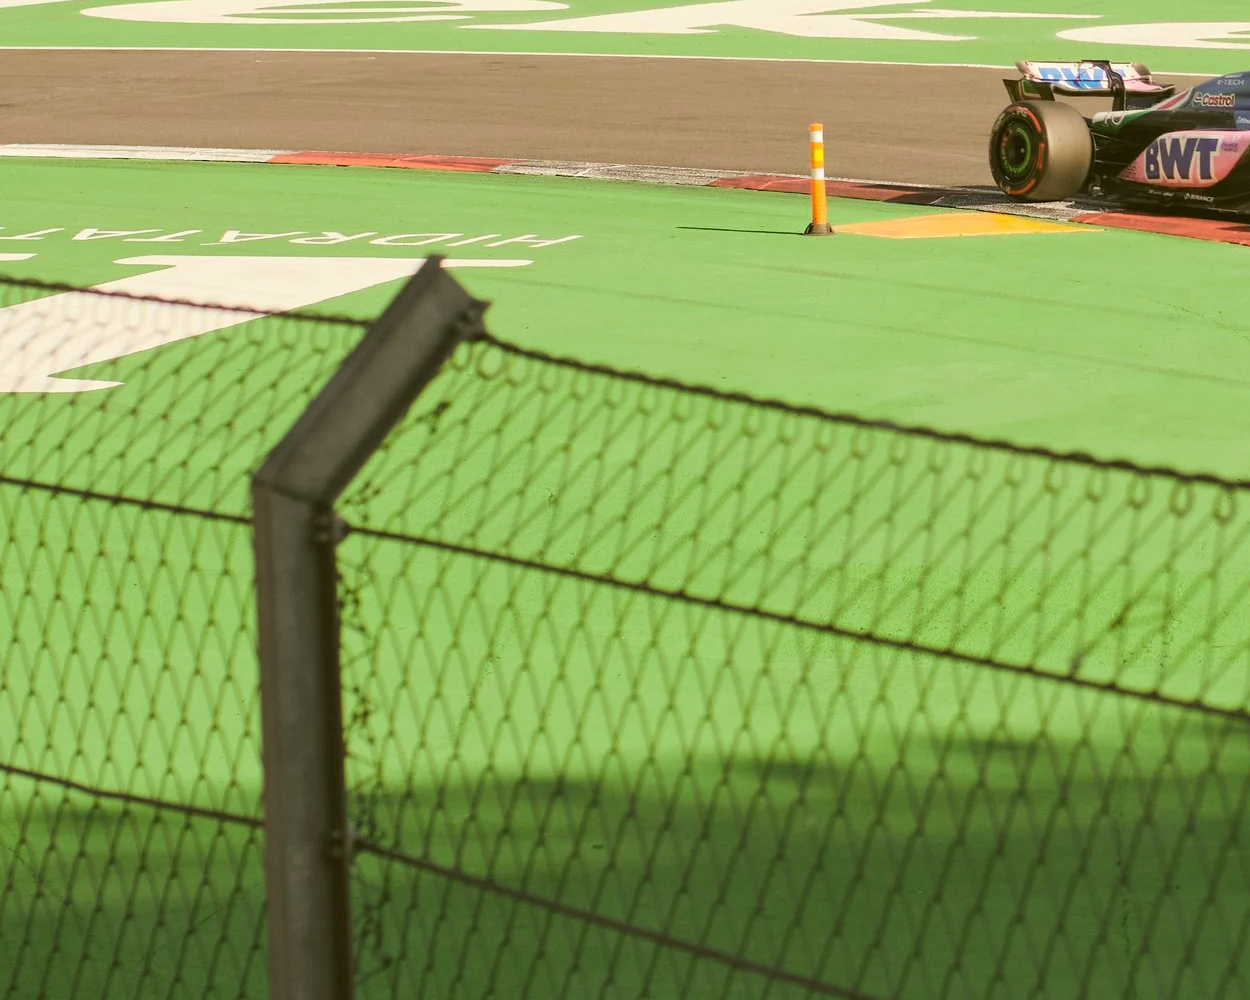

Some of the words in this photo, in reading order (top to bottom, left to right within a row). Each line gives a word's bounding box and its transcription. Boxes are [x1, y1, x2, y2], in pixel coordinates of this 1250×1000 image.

[1201, 93, 1236, 108] Castrol
[1145, 136, 1222, 182] BWT
[0, 226, 584, 249] HIDRÁTAT
